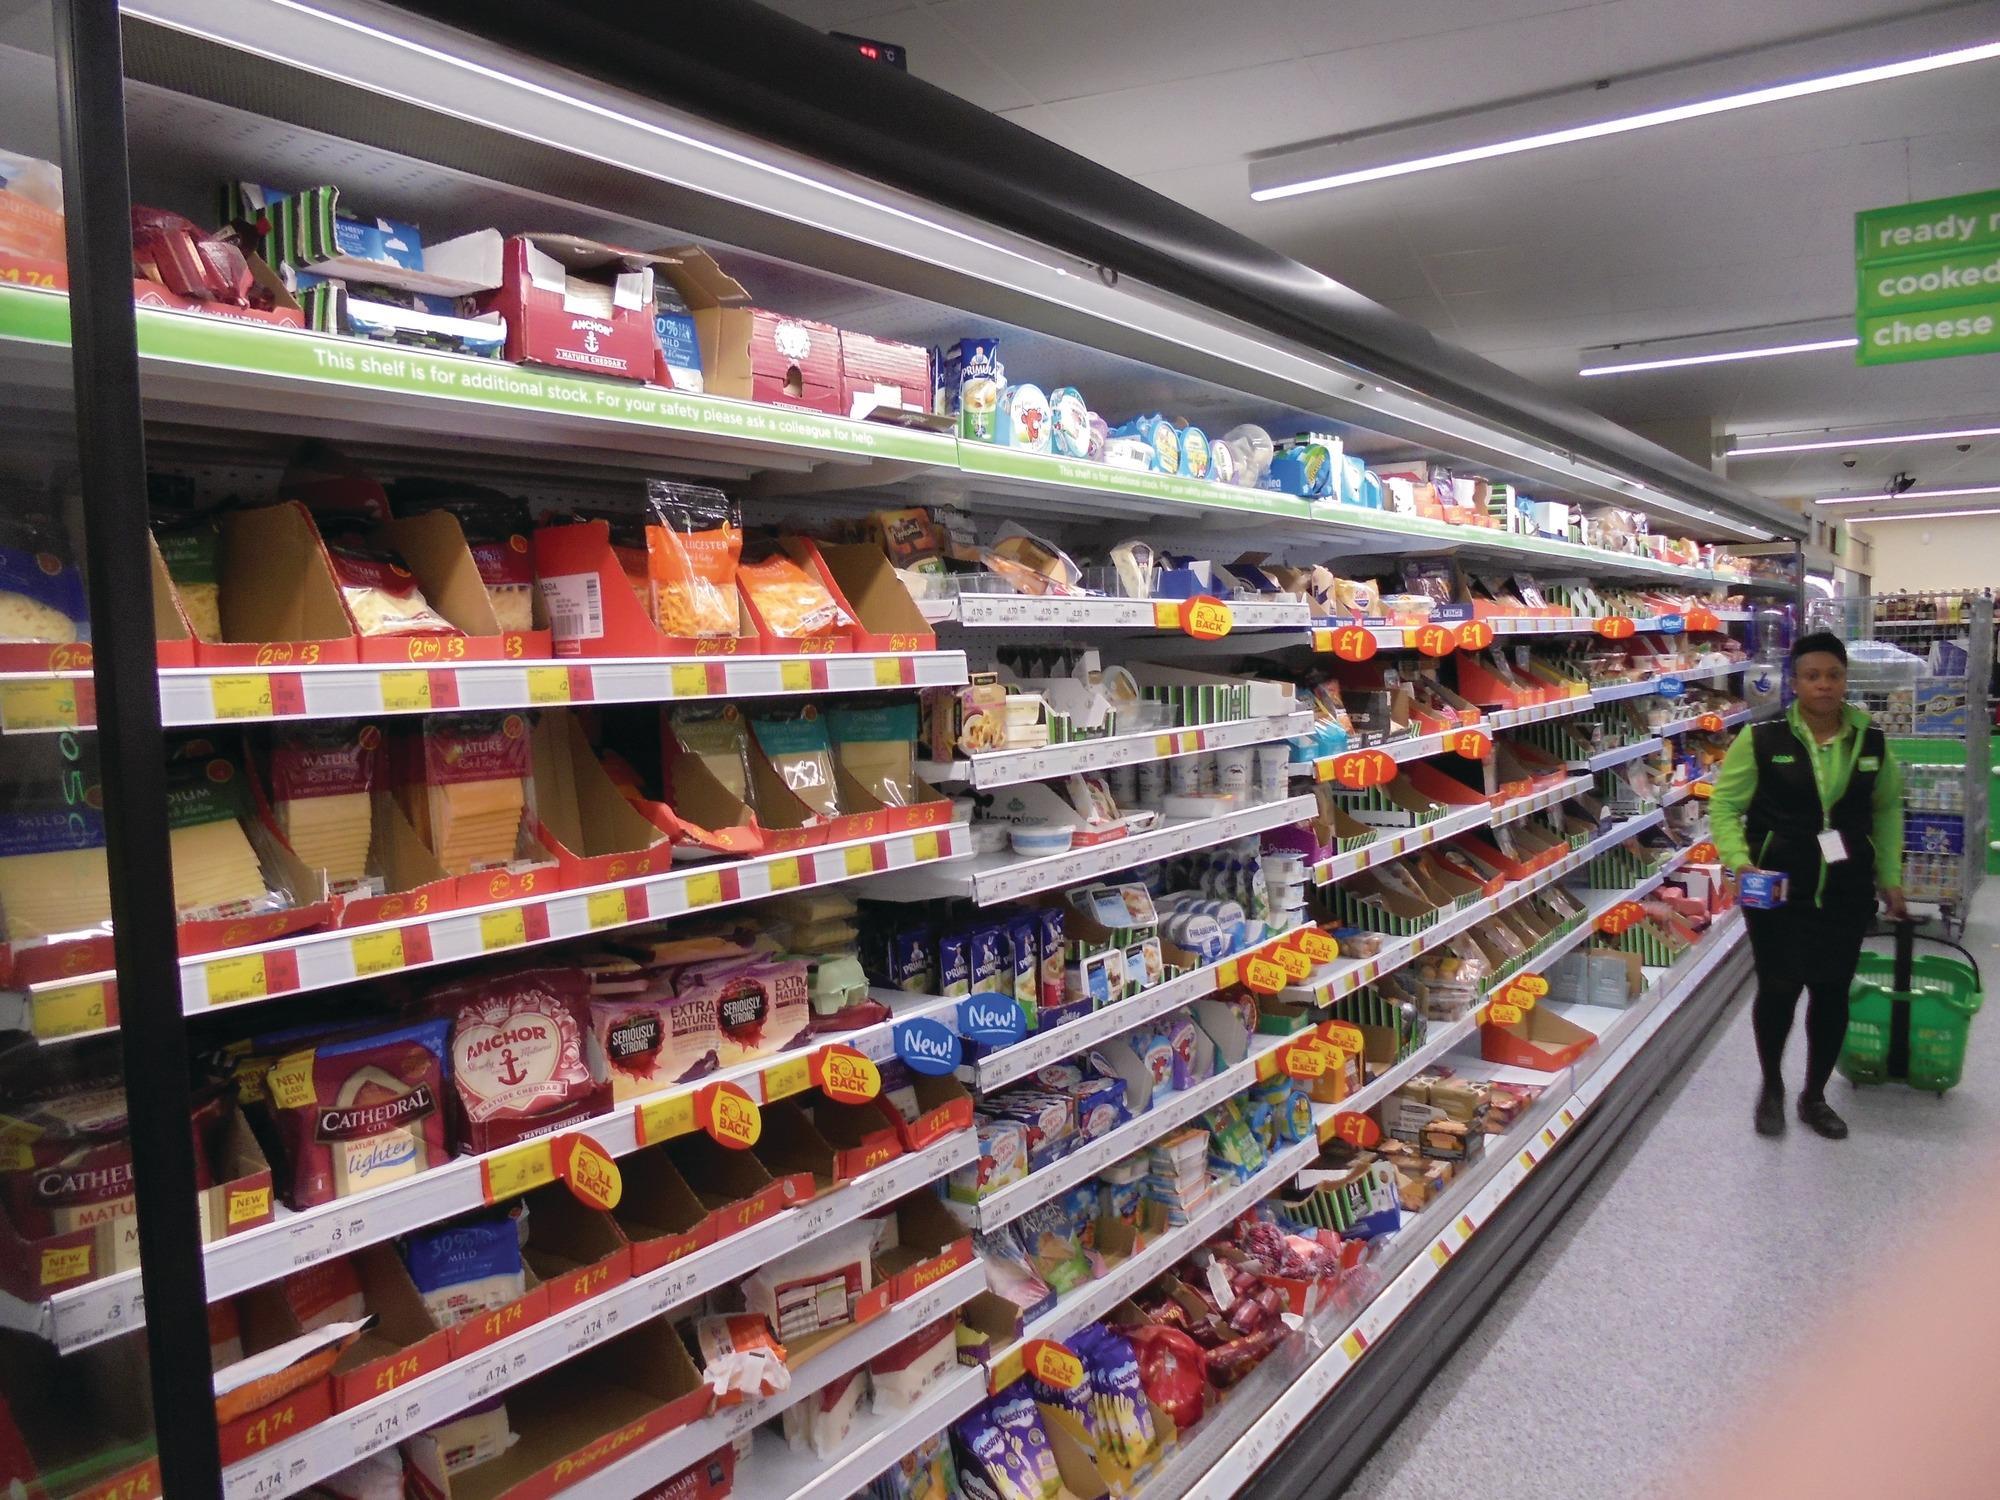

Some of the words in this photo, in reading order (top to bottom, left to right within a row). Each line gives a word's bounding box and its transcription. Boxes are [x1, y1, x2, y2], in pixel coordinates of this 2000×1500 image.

[1881, 215, 1977, 248] ready
[1878, 257, 2000, 297] cooked
[572, 320, 613, 337] ANCHOR
[1874, 316, 1993, 346] cheese
[962, 364, 997, 378] PRIMULA
[314, 349, 355, 370] This
[361, 353, 405, 377] shelf
[411, 367, 425, 380] is
[430, 365, 456, 384] for
[461, 371, 543, 396] additional
[547, 385, 592, 404] stock.
[596, 391, 620, 408] For
[625, 399, 663, 418] your
[660, 398, 700, 421] safety
[704, 408, 743, 429] please
[746, 415, 767, 430] ask
[768, 421, 776, 431] a
[779, 419, 831, 440] colleague
[833, 425, 850, 441] for
[1196, 620, 1222, 632] BACK
[1197, 609, 1226, 624] ROLL
[1461, 626, 1482, 647] £1
[1603, 621, 1621, 637] £1
[413, 640, 424, 657] 2
[424, 640, 439, 652] for
[447, 638, 465, 658] £3
[506, 636, 524, 658] £3
[700, 640, 709, 653] 2
[724, 638, 737, 654] £3
[824, 638, 837, 653] £3
[1341, 630, 1364, 659] £1
[1423, 630, 1444, 654] £1
[57, 651, 72, 670] 2
[73, 650, 93, 666] for
[259, 650, 273, 667] 2
[273, 648, 293, 661] for
[301, 644, 320, 664] £3
[453, 740, 503, 754] MATURE
[1461, 735, 1481, 758] £1
[302, 754, 358, 768] MATURE
[1343, 758, 1366, 786] £1
[520, 873, 534, 890] £3
[414, 895, 428, 913] £3
[1603, 914, 1620, 932] £1
[1252, 974, 1278, 988] BACK
[1253, 965, 1280, 981] ROLL
[776, 987, 808, 1002] MATUR
[671, 1000, 716, 1019] EXTRA
[724, 995, 761, 1017] SERIOUSLY
[672, 1013, 716, 1031] MATURE
[730, 1009, 756, 1026] STRONG
[969, 1005, 1017, 1028] New!
[612, 1022, 656, 1044] SERIOUSLY
[466, 1026, 547, 1062] ANCHOR
[620, 1038, 649, 1057] STRONG
[905, 1029, 953, 1059] New!
[277, 1071, 306, 1087] NEW
[829, 1061, 869, 1081] ROLL
[285, 1085, 304, 1096] EASY
[830, 1076, 867, 1094] BACK
[481, 1093, 515, 1114] MATURE
[516, 1084, 559, 1098] CHEDDAR
[322, 1088, 430, 1132] CATHEDRAL
[719, 1102, 752, 1127] ROLL
[366, 1121, 388, 1134] CITY
[522, 1123, 549, 1140] MATURE
[551, 1114, 586, 1132] CHEDDAR
[719, 1118, 751, 1139] BACK
[1343, 1117, 1367, 1144] £1
[347, 1139, 376, 1153] MATURE
[348, 1139, 413, 1178] lighter
[38, 1163, 133, 1197] CATHE
[577, 1157, 613, 1190] ROLL
[100, 1184, 129, 1197] CITY
[576, 1171, 610, 1201] BACK
[236, 1194, 262, 1208] NEW
[79, 1203, 135, 1227] MATU
[49, 1253, 82, 1266] NEW
[449, 1250, 478, 1264] MILD
[484, 1303, 523, 1335] £1.74
[375, 1356, 419, 1389] £1.74
[1043, 1364, 1073, 1383] BACK
[246, 1406, 295, 1446] £1.74
